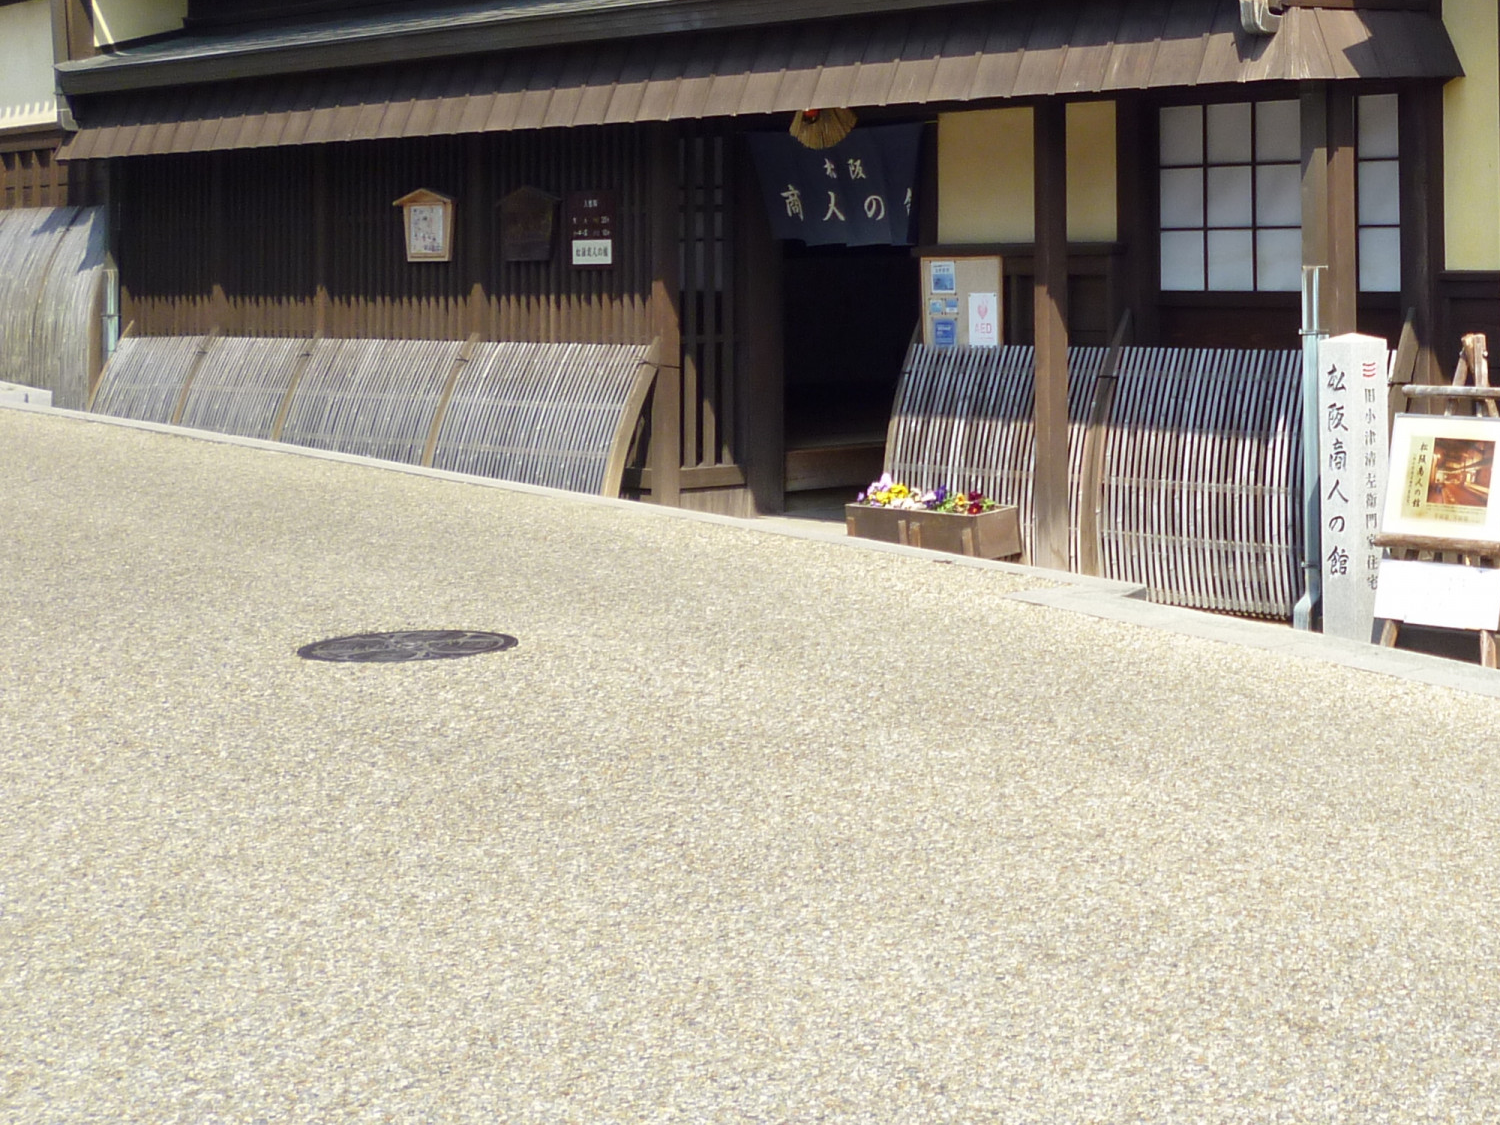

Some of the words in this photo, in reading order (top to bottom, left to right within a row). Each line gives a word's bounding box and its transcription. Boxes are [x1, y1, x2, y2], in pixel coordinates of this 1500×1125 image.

[1327, 363, 1350, 577] 松阪商人の館
